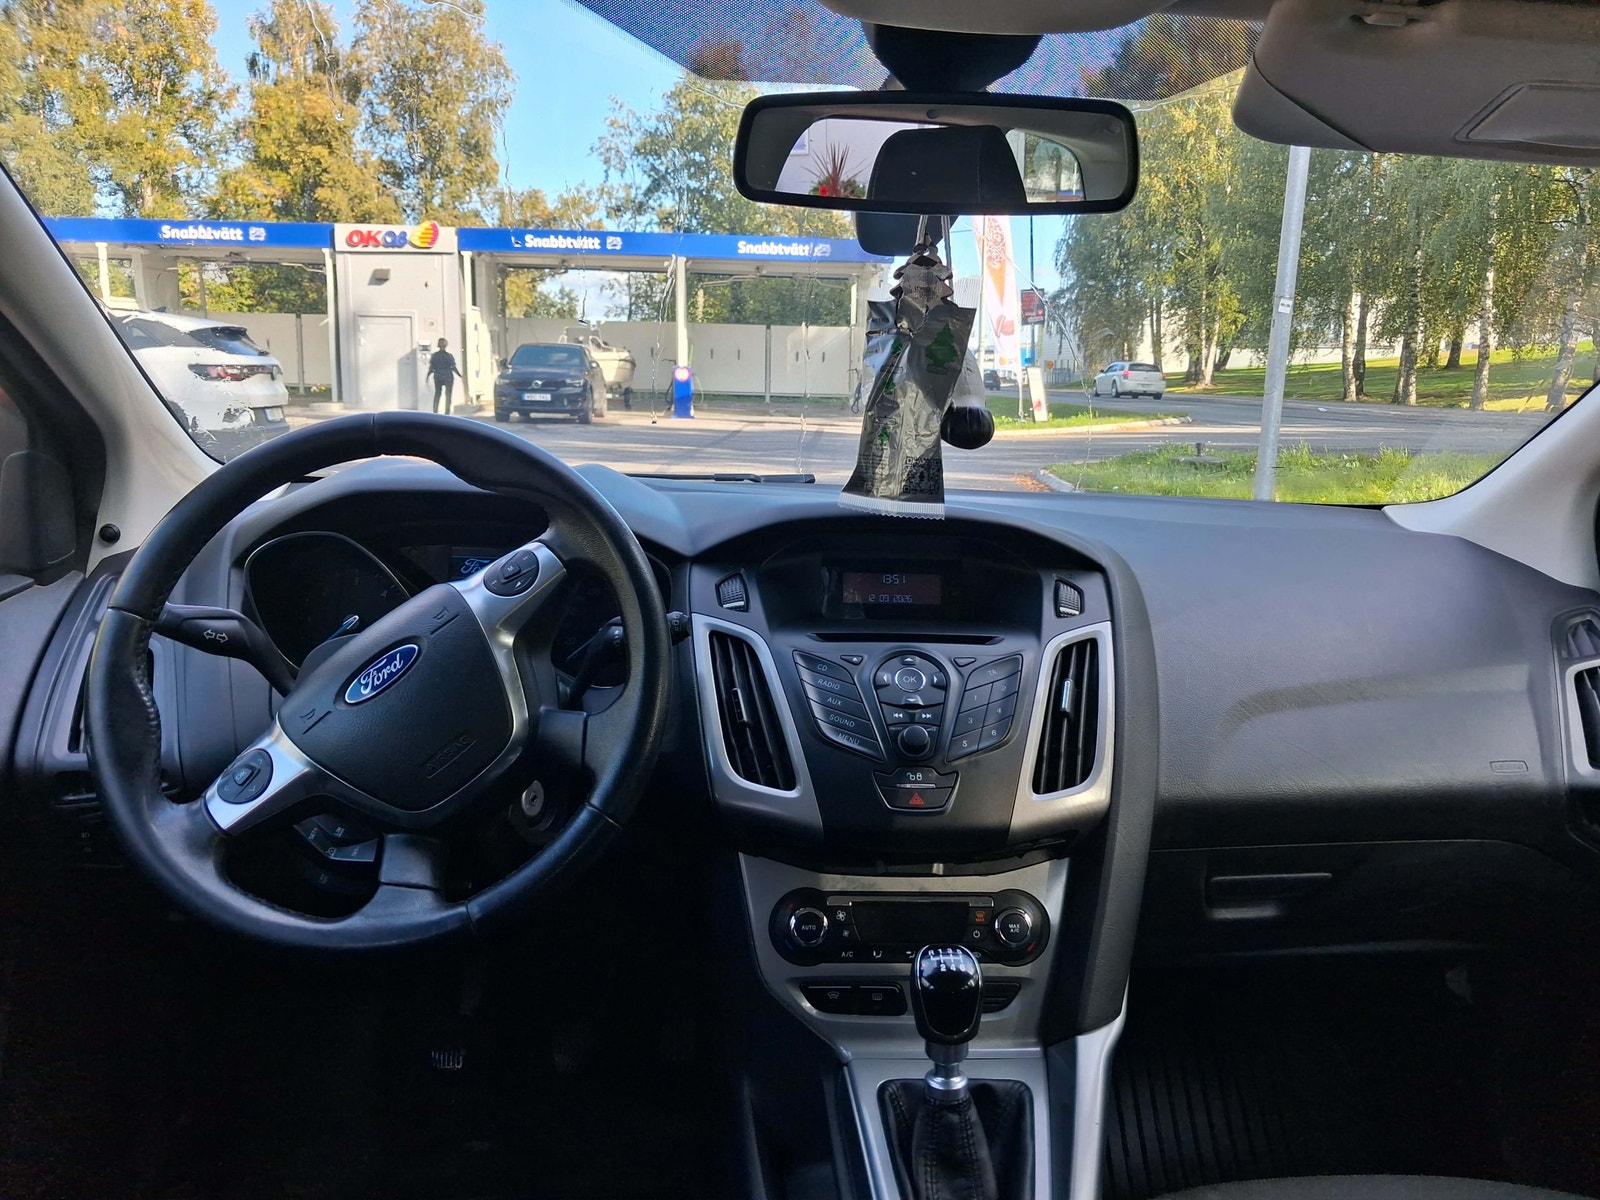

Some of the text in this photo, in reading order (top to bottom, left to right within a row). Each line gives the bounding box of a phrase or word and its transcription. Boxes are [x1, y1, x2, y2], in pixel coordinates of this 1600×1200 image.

[161, 224, 244, 241] Snabbtvätt
[524, 234, 601, 250] Snabbtvätt
[737, 240, 810, 257] Snabbtvätt
[360, 652, 404, 695] Ford
[817, 663, 828, 672] CD
[818, 678, 840, 690] RADIO
[902, 675, 917, 683] OK
[827, 697, 842, 706] AUX
[829, 713, 855, 728] SOUND
[837, 733, 860, 746] MENU
[940, 963, 947, 972] 2
[950, 963, 956, 972] 4
